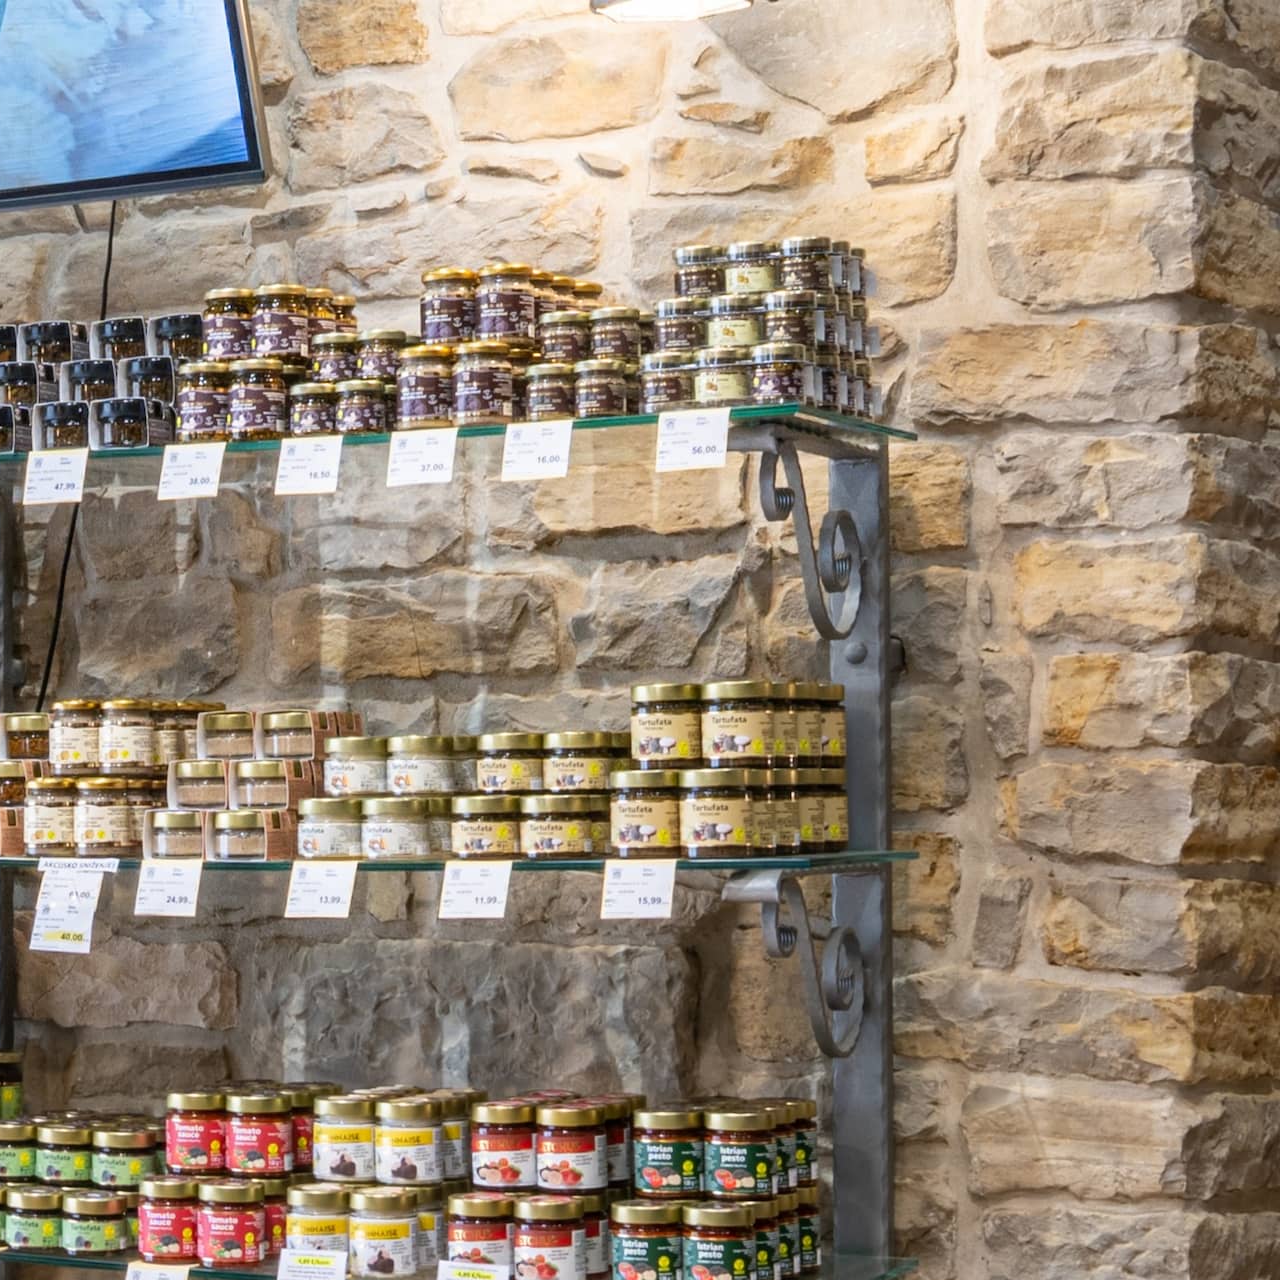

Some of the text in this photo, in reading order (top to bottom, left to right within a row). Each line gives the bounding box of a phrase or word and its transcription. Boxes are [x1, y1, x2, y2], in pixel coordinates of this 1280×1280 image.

[175, 1125, 204, 1133] Tomato
[233, 1127, 262, 1135] Tomato
[646, 1144, 674, 1153] Istrian
[719, 1146, 748, 1156] Istrian
[648, 1153, 672, 1161] pesto
[720, 1154, 747, 1164] pesto
[146, 1212, 176, 1220] Tomato
[208, 1216, 238, 1225] Tomato
[211, 1223, 235, 1231] sauce
[622, 1241, 649, 1250] Istrian
[696, 1242, 725, 1252] Istrian
[624, 1249, 648, 1257] pesto
[698, 1251, 724, 1260] pesto
